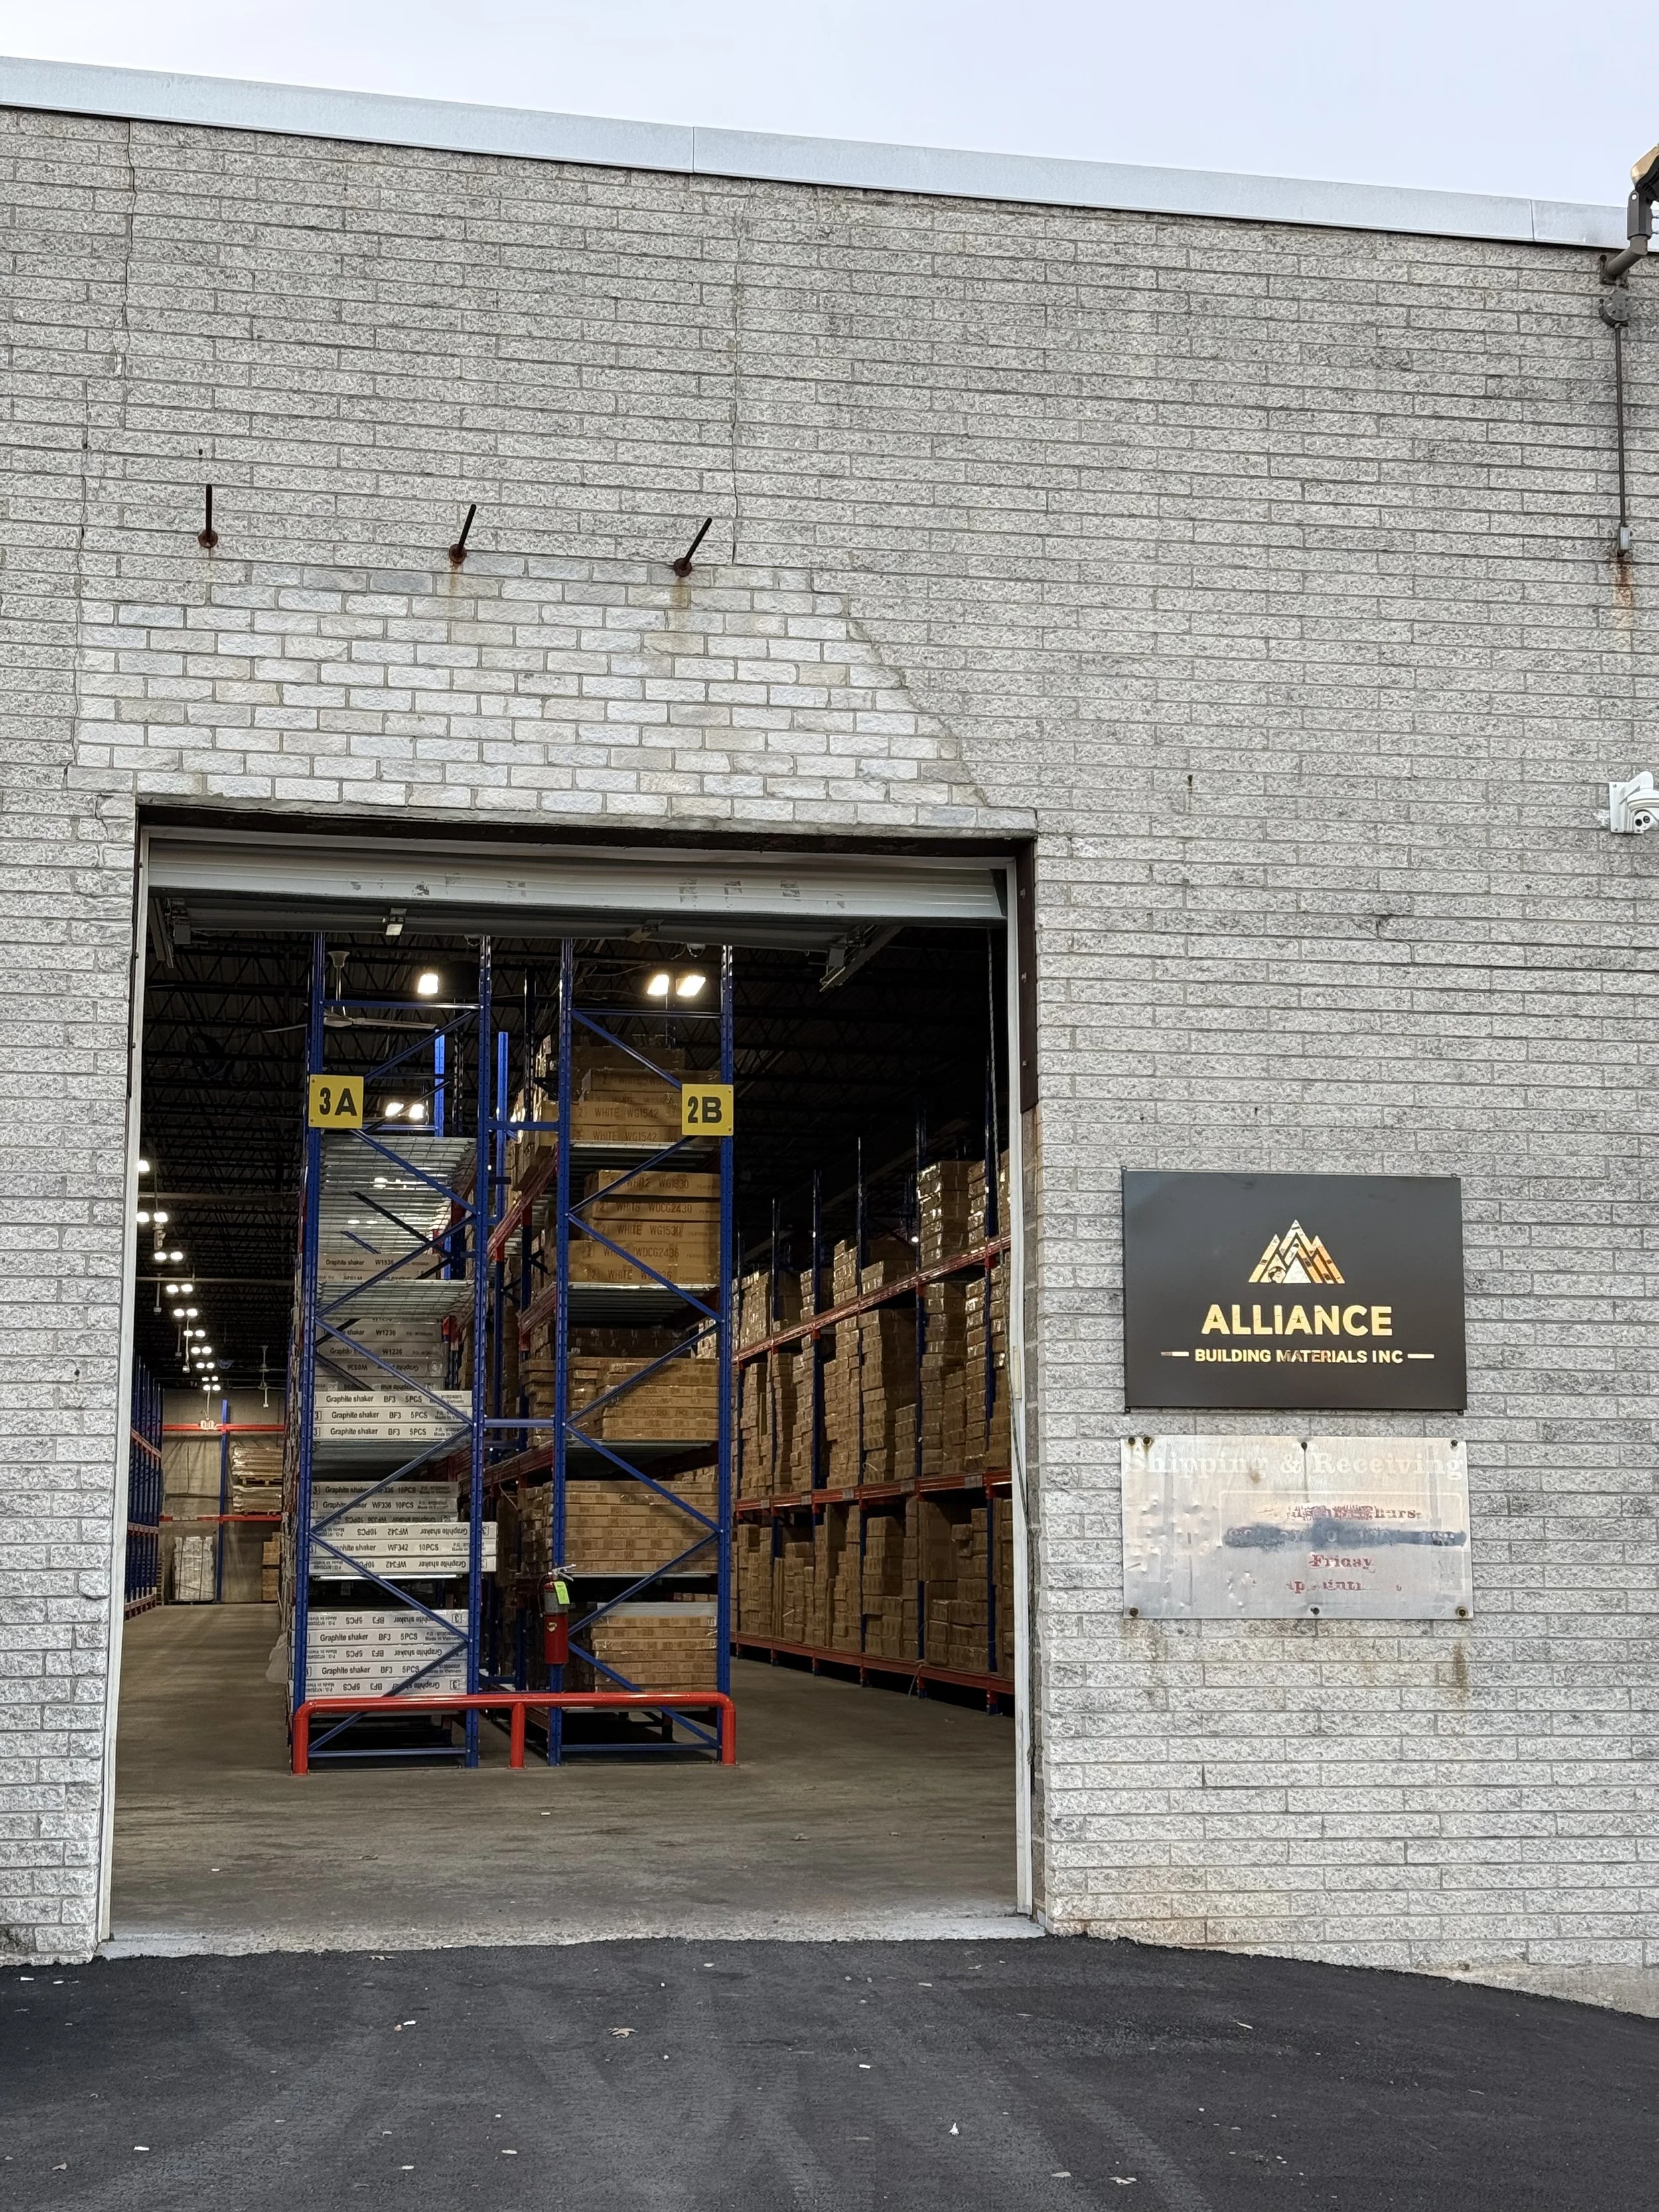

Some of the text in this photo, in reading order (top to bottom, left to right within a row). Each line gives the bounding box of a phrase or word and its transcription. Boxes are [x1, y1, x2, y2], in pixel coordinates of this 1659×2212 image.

[319, 1086, 357, 1116] 3A
[595, 1108, 619, 1118] WHITE
[626, 1109, 659, 1118] WG1542
[687, 1096, 722, 1124] 2B
[593, 1130, 618, 1140] WHITE
[625, 1132, 657, 1142] WG1542
[648, 1203, 692, 1214] WDCG2430
[617, 1224, 642, 1236] WHITE
[650, 1226, 681, 1236] WG1530
[635, 1247, 679, 1258] WDCG2436
[607, 1269, 632, 1280] WHITE
[1201, 1304, 1393, 1337] ALLIANCE
[1195, 1349, 1404, 1364] BUILDING MATERIALS INC
[326, 1395, 352, 1406] Graphite
[331, 1412, 358, 1422] Graphite
[330, 1428, 357, 1438] Graphite
[1126, 1447, 1466, 1481] Shipping & Receiving
[325, 1486, 349, 1495] Graphite
[441, 1527, 469, 1537] Graphite
[440, 1560, 467, 1570] Graphite
[454, 1614, 460, 1623] 3
[320, 1634, 346, 1644] Graphite
[415, 1647, 443, 1657] Graphite
[321, 1666, 348, 1676] Graphite
[413, 1682, 440, 1691] Graphite
